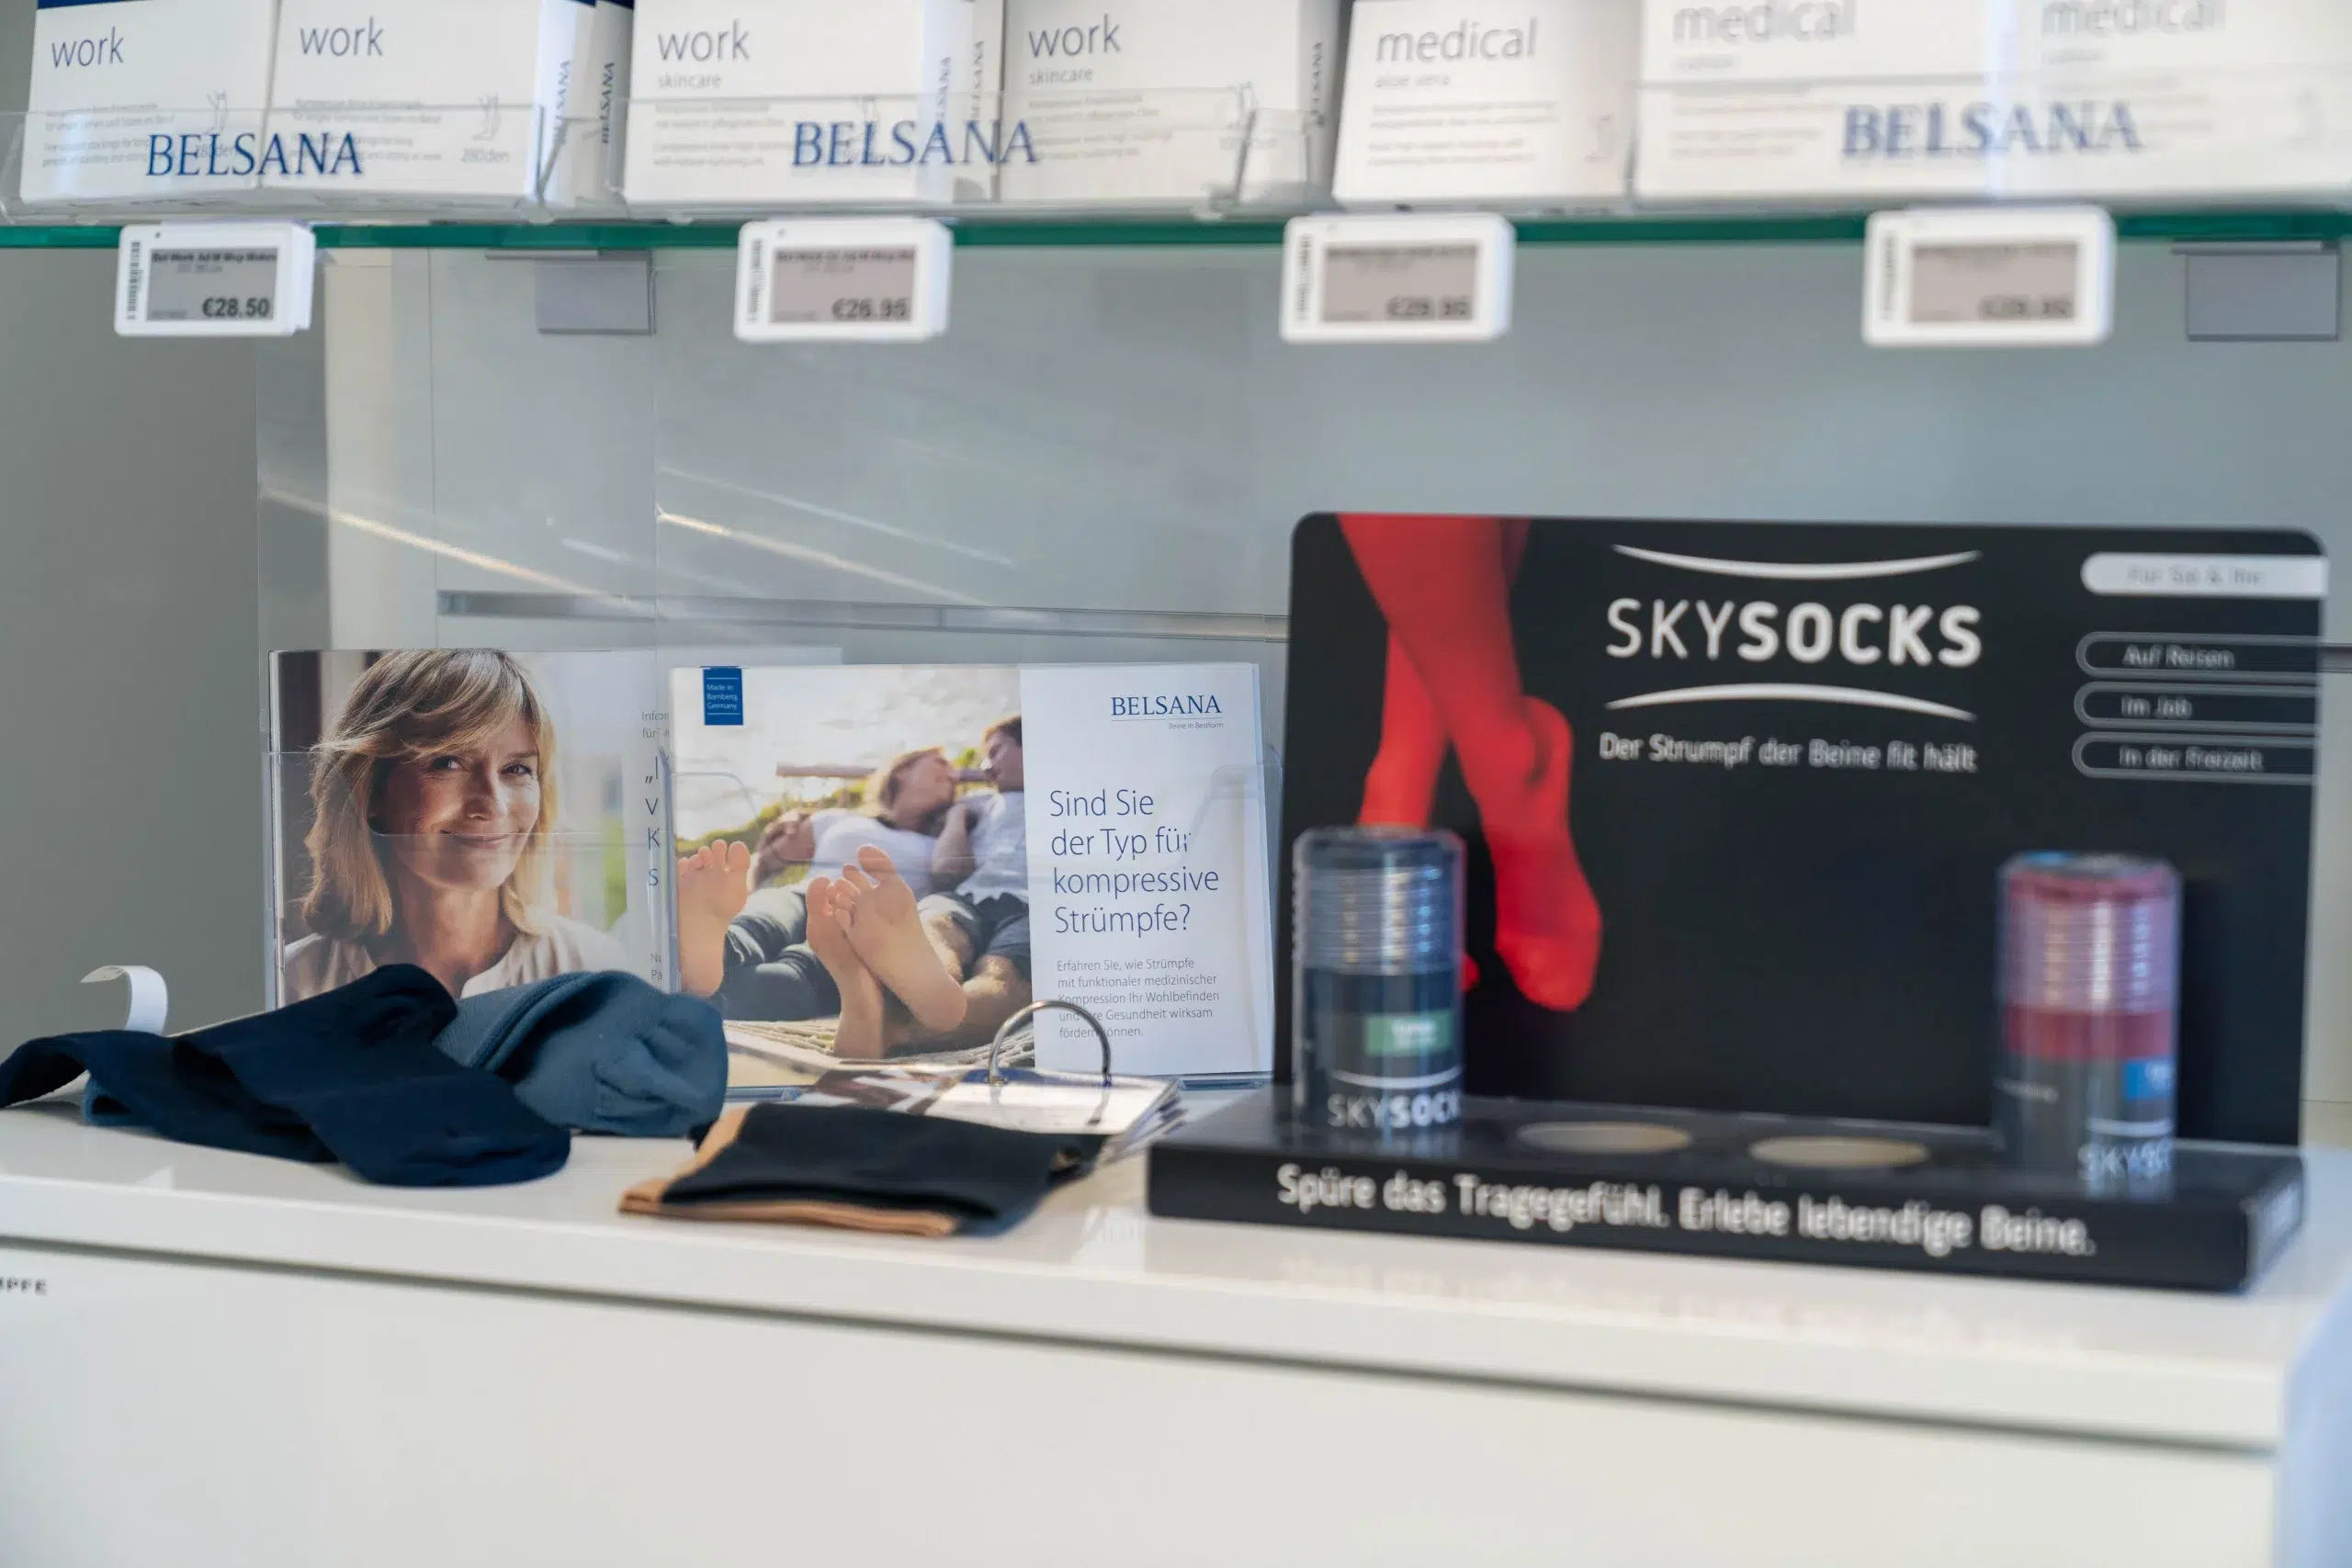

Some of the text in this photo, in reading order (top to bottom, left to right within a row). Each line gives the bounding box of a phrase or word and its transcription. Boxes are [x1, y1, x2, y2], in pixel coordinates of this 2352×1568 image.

[51, 27, 124, 68] work
[300, 17, 383, 57] work
[656, 18, 751, 62] work
[1028, 13, 1122, 59] work
[1375, 16, 1538, 62] medical
[657, 73, 722, 89] skincare
[1029, 66, 1095, 85] skincare
[792, 119, 1039, 167] BELSANA
[1842, 98, 2145, 158] BELSANA
[146, 132, 363, 176] BELSANA
[201, 296, 271, 318] €28.50
[1605, 597, 1983, 668] SKYSOCKS
[2122, 644, 2235, 670] Auf Reisen
[707, 703, 738, 712] Germany
[1111, 694, 1223, 716] BELSANA
[2120, 694, 2193, 719] Im Job
[643, 728, 656, 739] für
[1600, 731, 1978, 773] Der Strumpf der Beine fit hält
[2145, 746, 2182, 770] der
[2185, 745, 2265, 773] Freizeit
[1050, 789, 1154, 817] Sind Sie
[1051, 826, 1192, 862] der Typ für
[1054, 866, 1219, 899] kompressive
[1056, 903, 1191, 939] Strümpfe?
[1057, 957, 1195, 972] Erfahren Sie, wie Strümpfe
[1057, 974, 1217, 988] mit funktionaler medizinischer
[1058, 990, 1219, 1007] Kompression Ihr Wohlbefinden
[1058, 1010, 1080, 1021] und
[1105, 1008, 1166, 1021] Gesundheit
[1170, 1007, 1213, 1020] wirksam
[1276, 1163, 2098, 1258] Spüre das Tragegefühl. Erlebe lebendige Beine.
